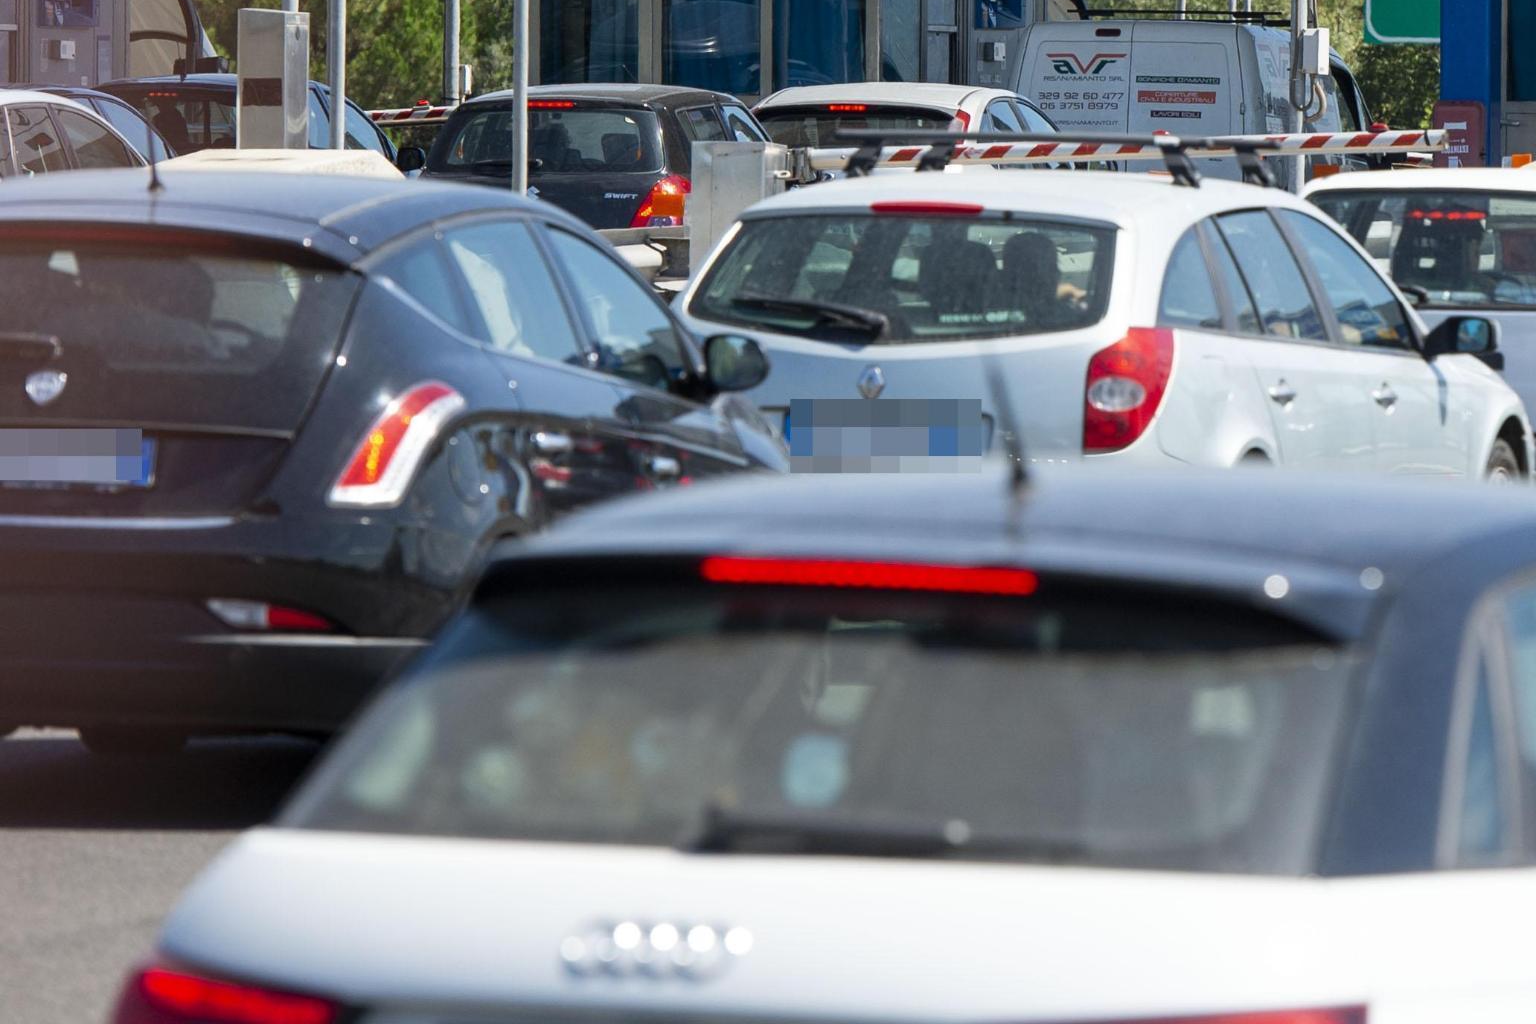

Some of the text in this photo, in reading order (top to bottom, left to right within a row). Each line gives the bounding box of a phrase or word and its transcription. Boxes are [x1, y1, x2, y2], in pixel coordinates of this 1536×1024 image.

[1038, 92, 1124, 100] 329 92 60 477
[1060, 102, 1084, 110] 3751
[1087, 102, 1119, 110] 8979
[604, 192, 639, 200] SWIFT
